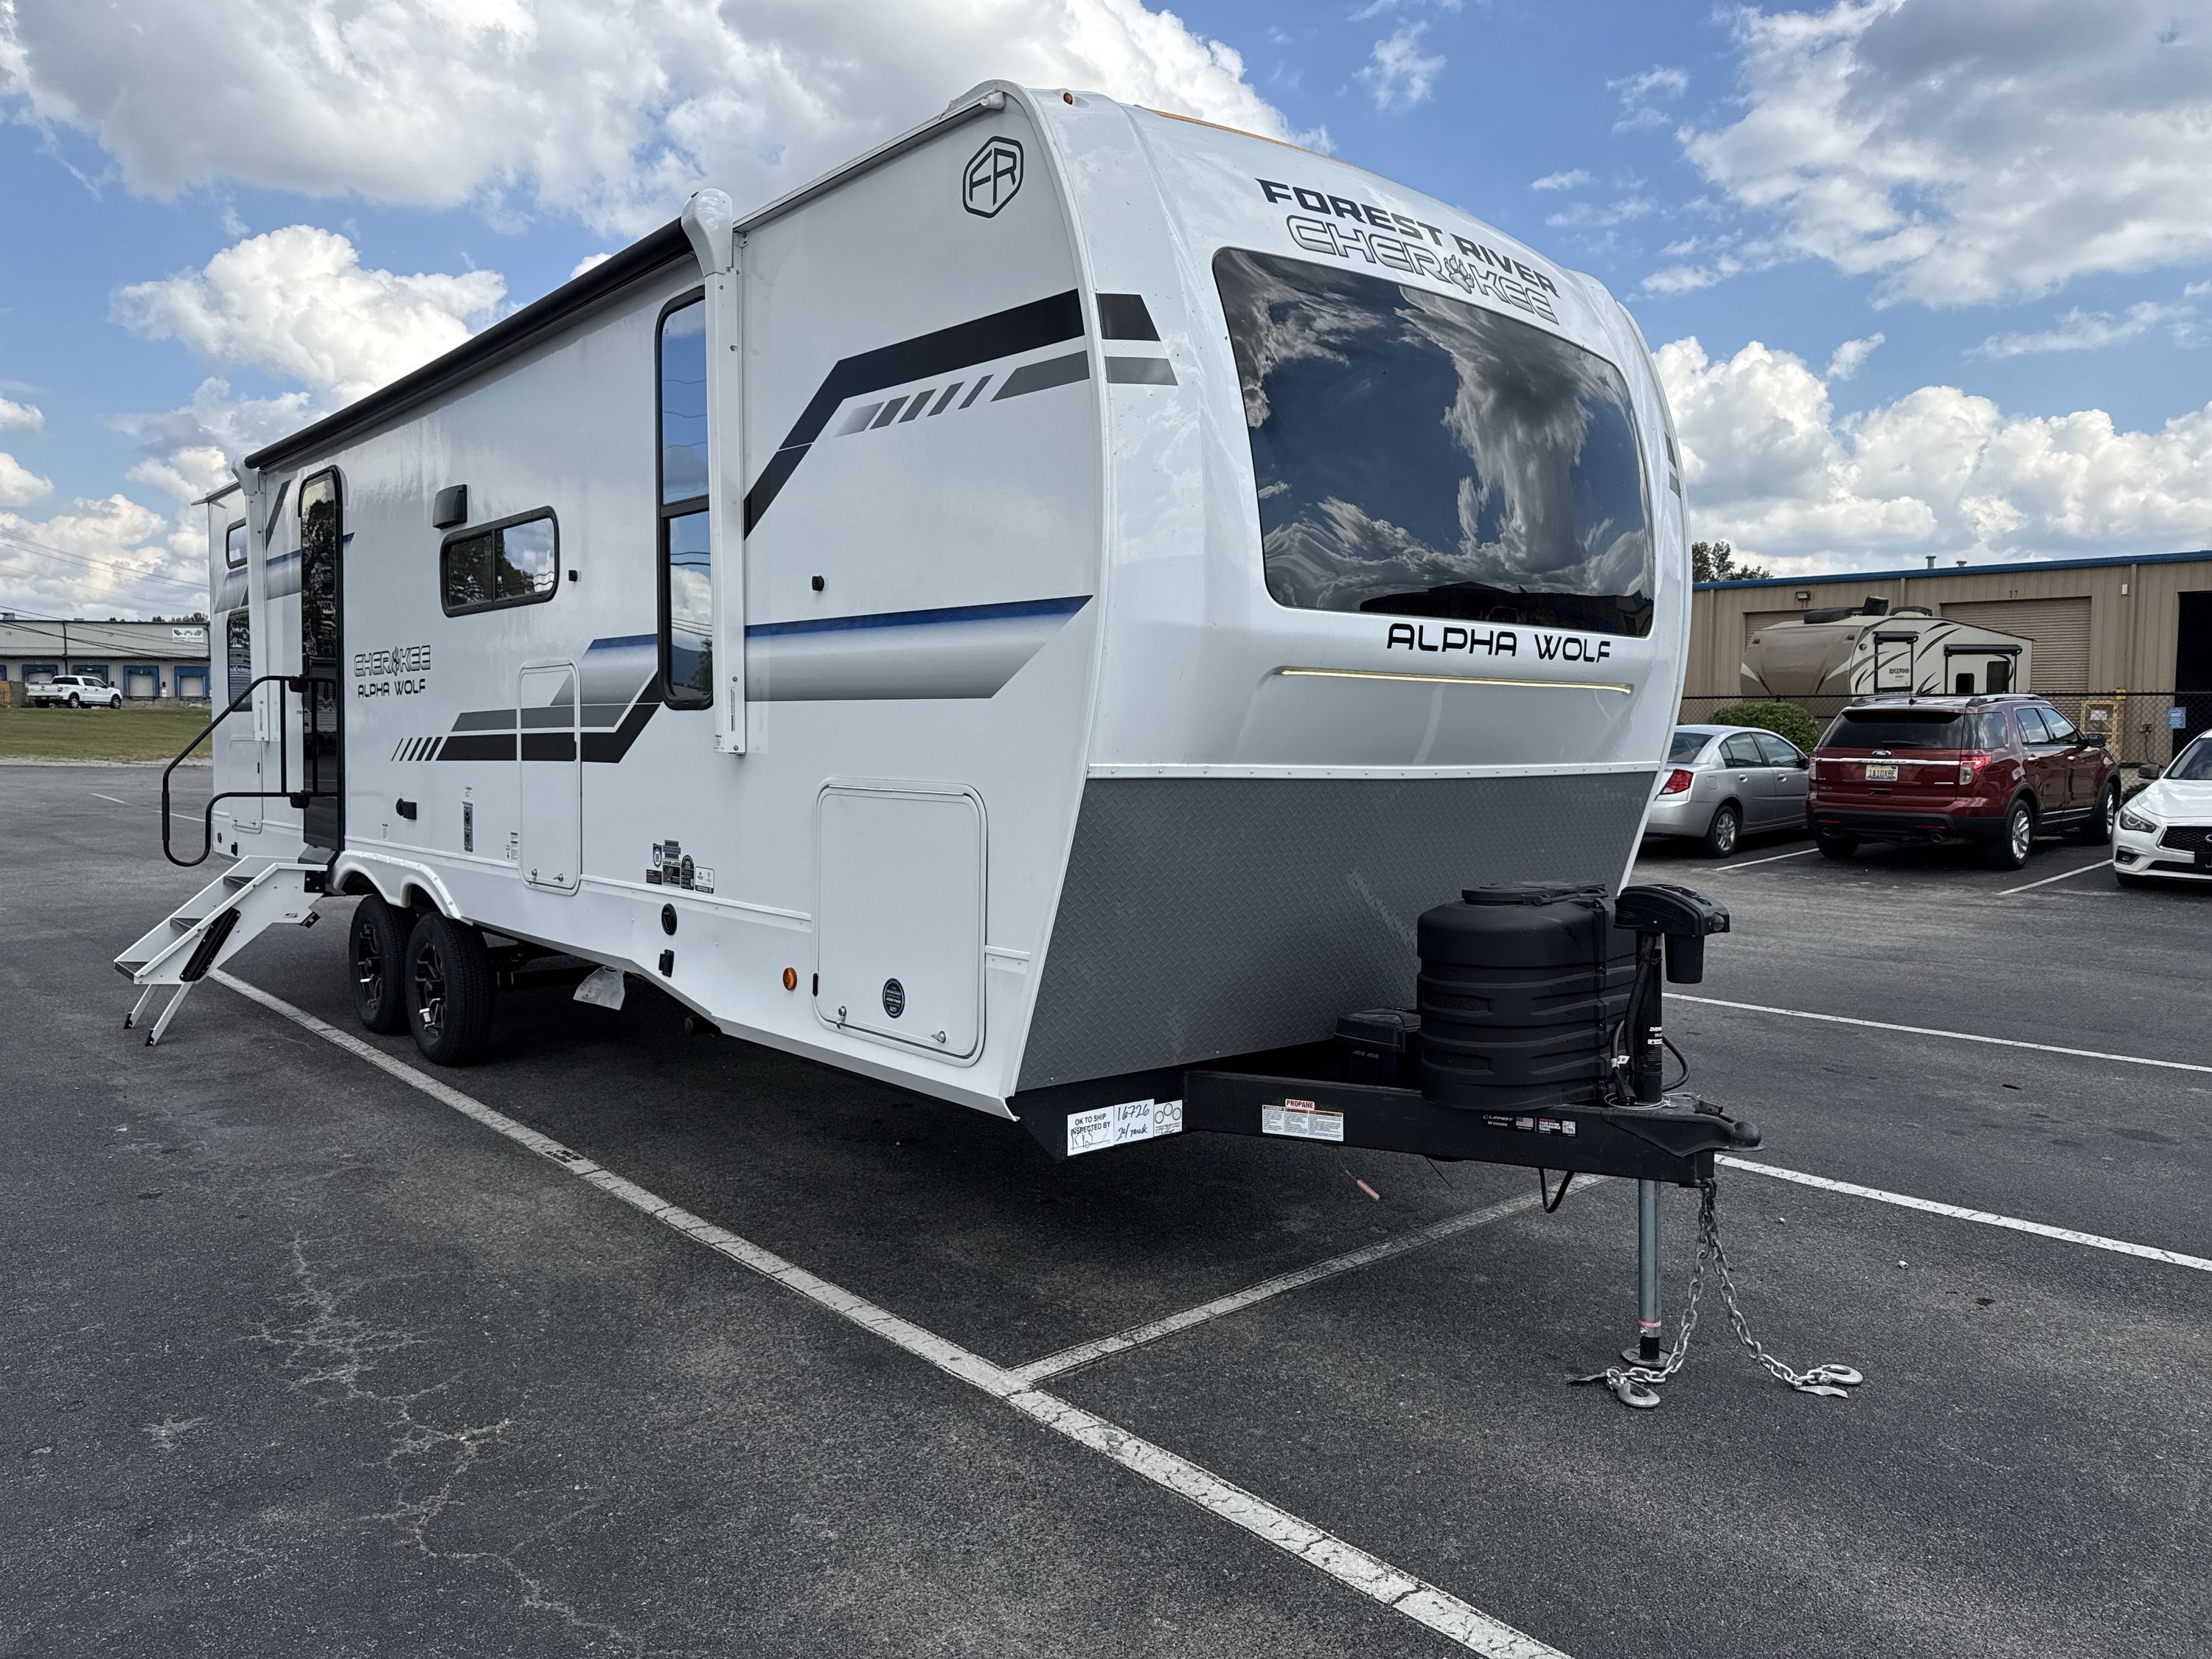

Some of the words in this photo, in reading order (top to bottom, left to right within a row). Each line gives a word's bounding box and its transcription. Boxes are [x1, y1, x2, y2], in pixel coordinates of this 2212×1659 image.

[1255, 178, 1443, 246] FOREST
[1450, 232, 1562, 299] RIVER
[1386, 622, 1517, 657] ALPHA
[1534, 633, 1611, 664] WOLF
[358, 682, 390, 698] ALPHA
[394, 678, 425, 695] WOLF
[1117, 1104, 1150, 1121] 16726
[1286, 1099, 1314, 1108] PROPANE
[1075, 1117, 1084, 1126] OK
[1093, 1113, 1107, 1121] SHIP
